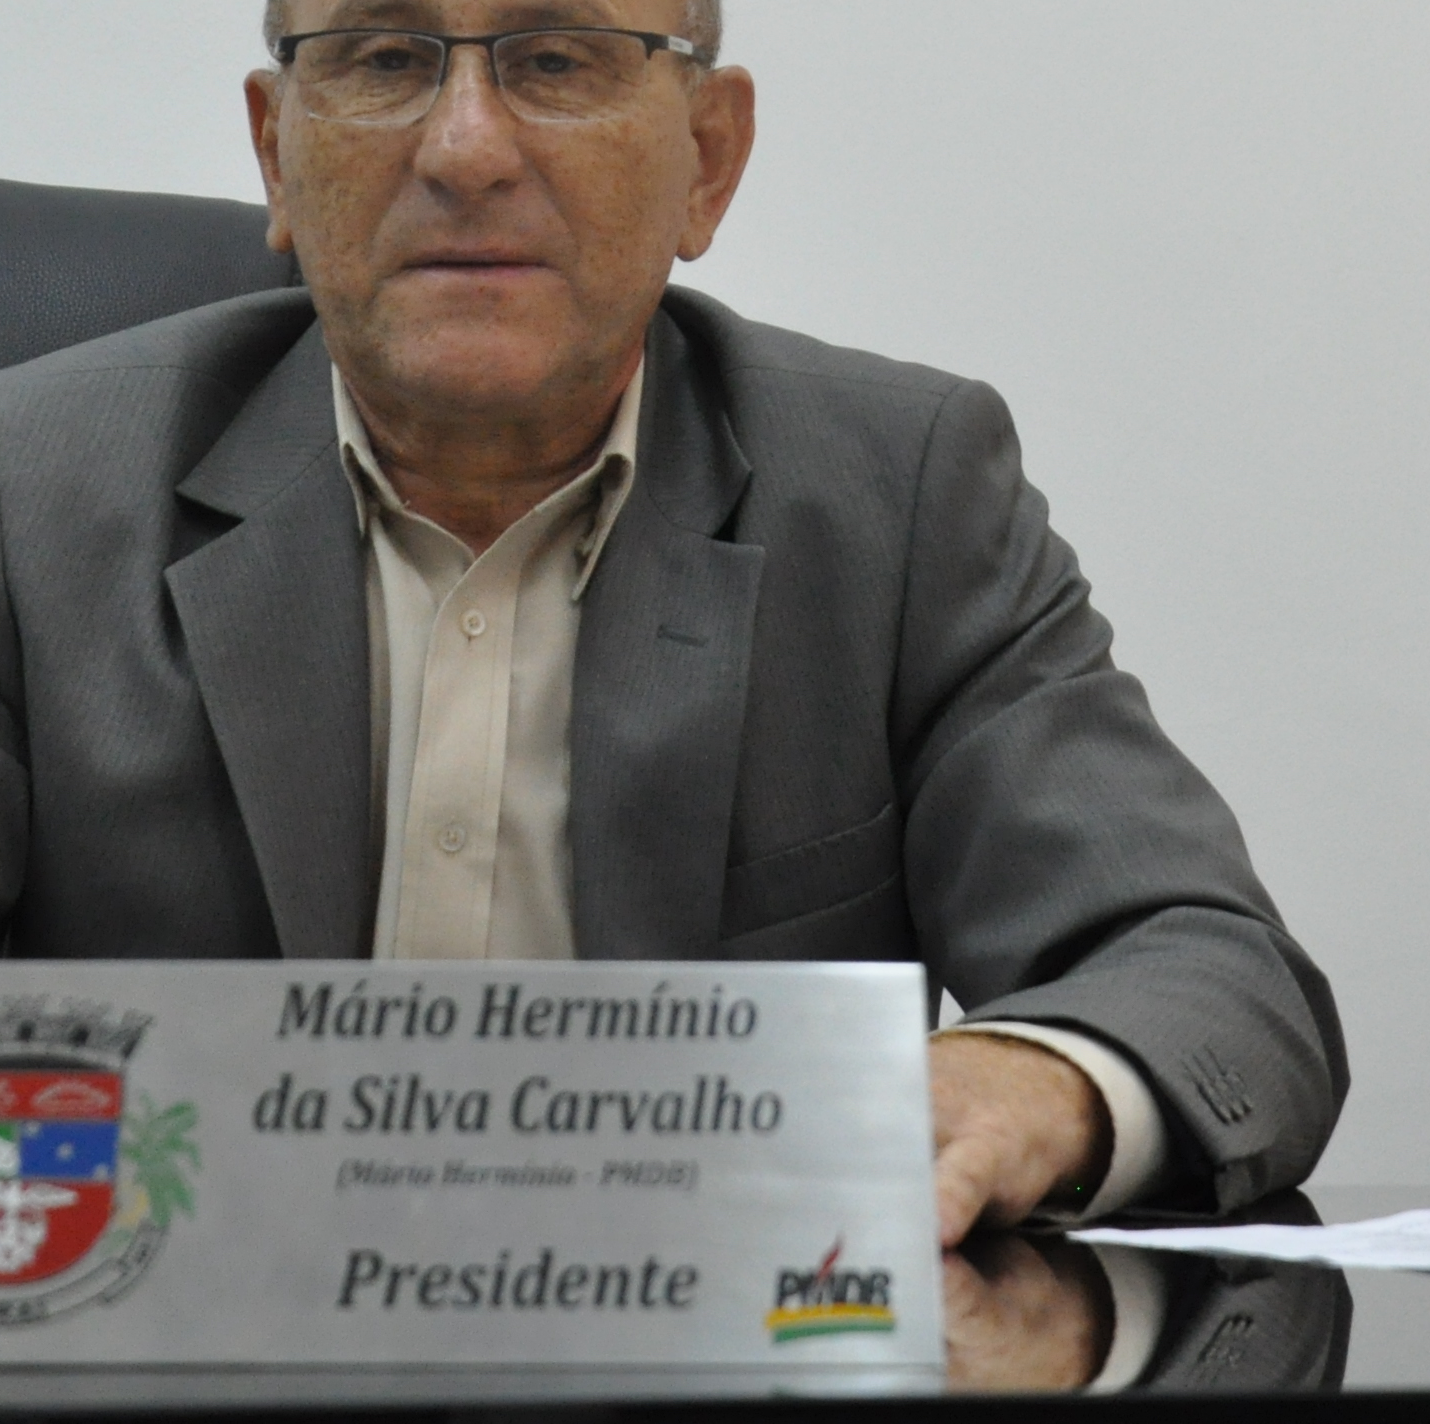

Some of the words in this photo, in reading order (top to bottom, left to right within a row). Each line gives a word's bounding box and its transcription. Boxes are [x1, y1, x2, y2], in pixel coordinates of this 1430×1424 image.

[275, 979, 458, 1041] Mário
[473, 979, 759, 1041] Hermínio
[252, 1074, 329, 1133] da
[342, 1074, 491, 1134] Silva
[510, 1075, 784, 1135] Carvalho
[335, 1246, 699, 1313] Presidente
[774, 1266, 892, 1310] PMDB
